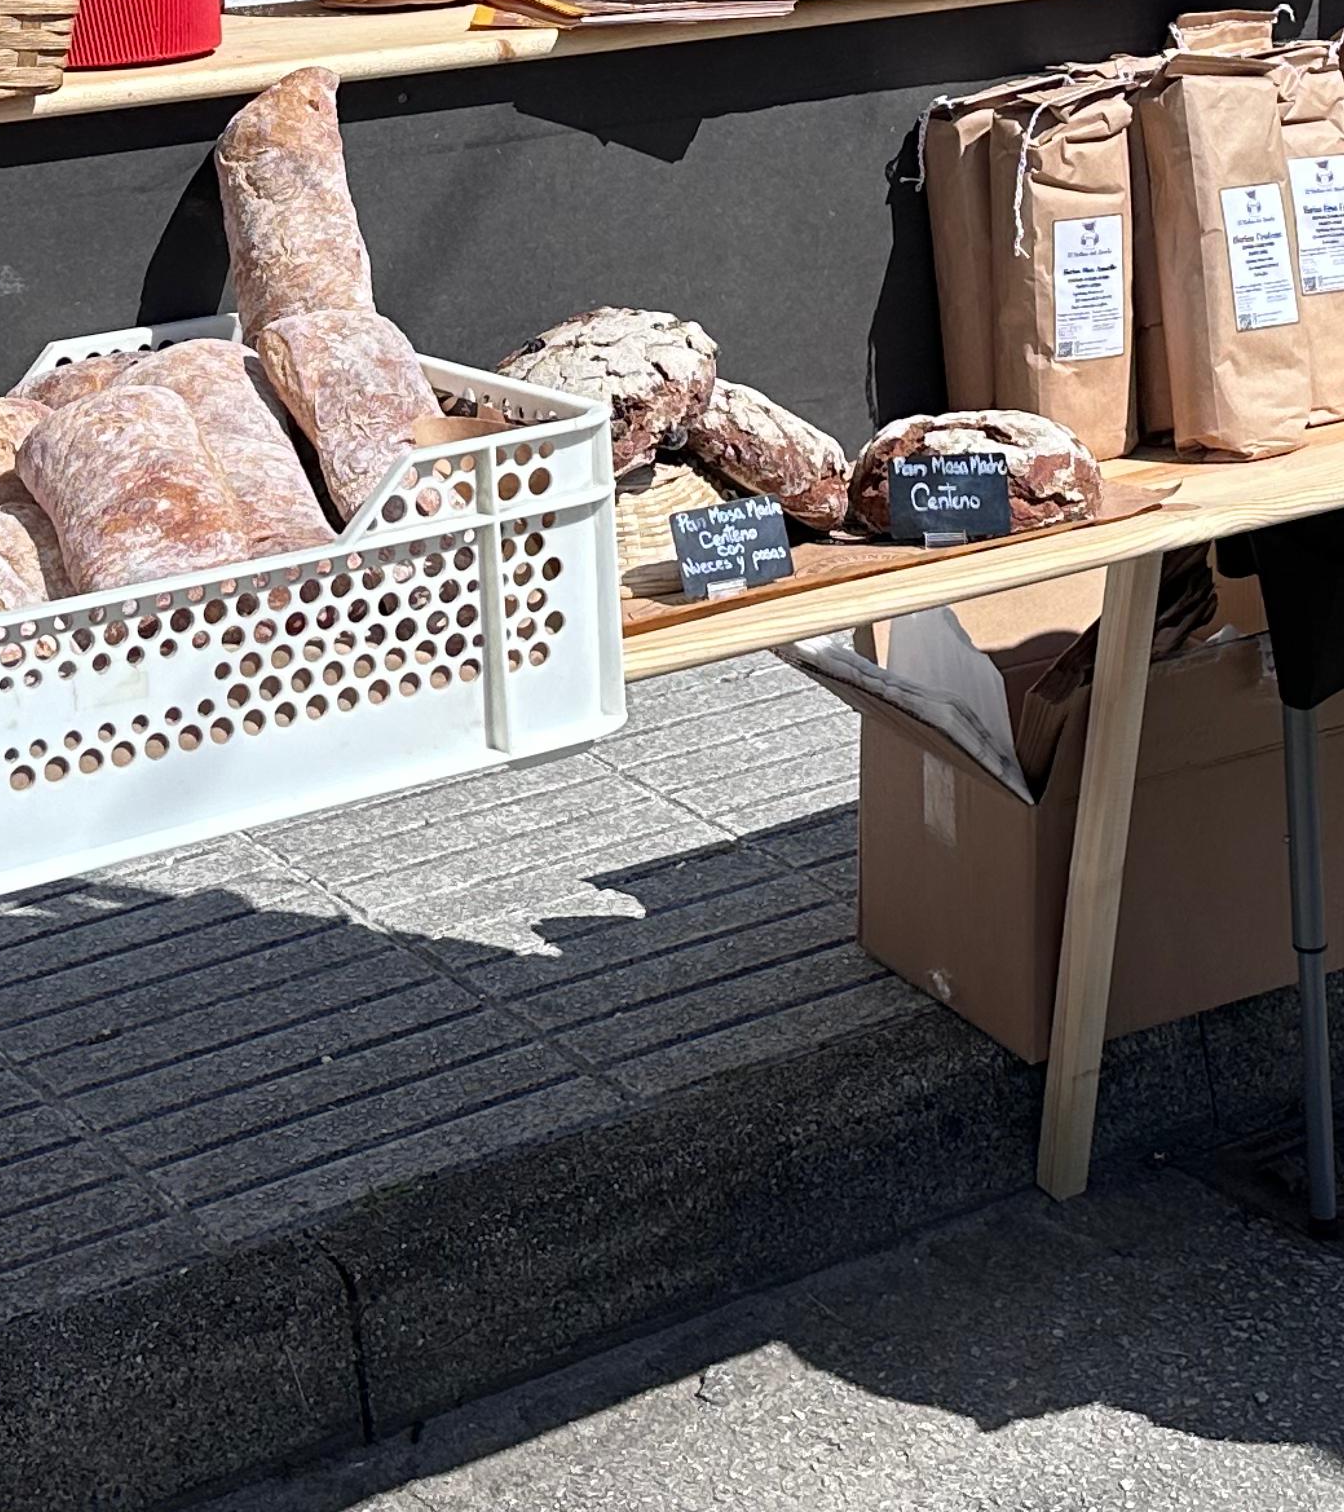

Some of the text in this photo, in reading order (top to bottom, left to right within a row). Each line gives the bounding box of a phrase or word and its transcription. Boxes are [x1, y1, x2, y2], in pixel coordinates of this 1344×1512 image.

[893, 453, 1007, 477] Pan Masa Madre
[911, 482, 981, 512] Centeno
[676, 513, 707, 533] Pan
[699, 524, 757, 549] Centeno
[682, 557, 733, 578] Nueces
[736, 555, 745, 575] y
